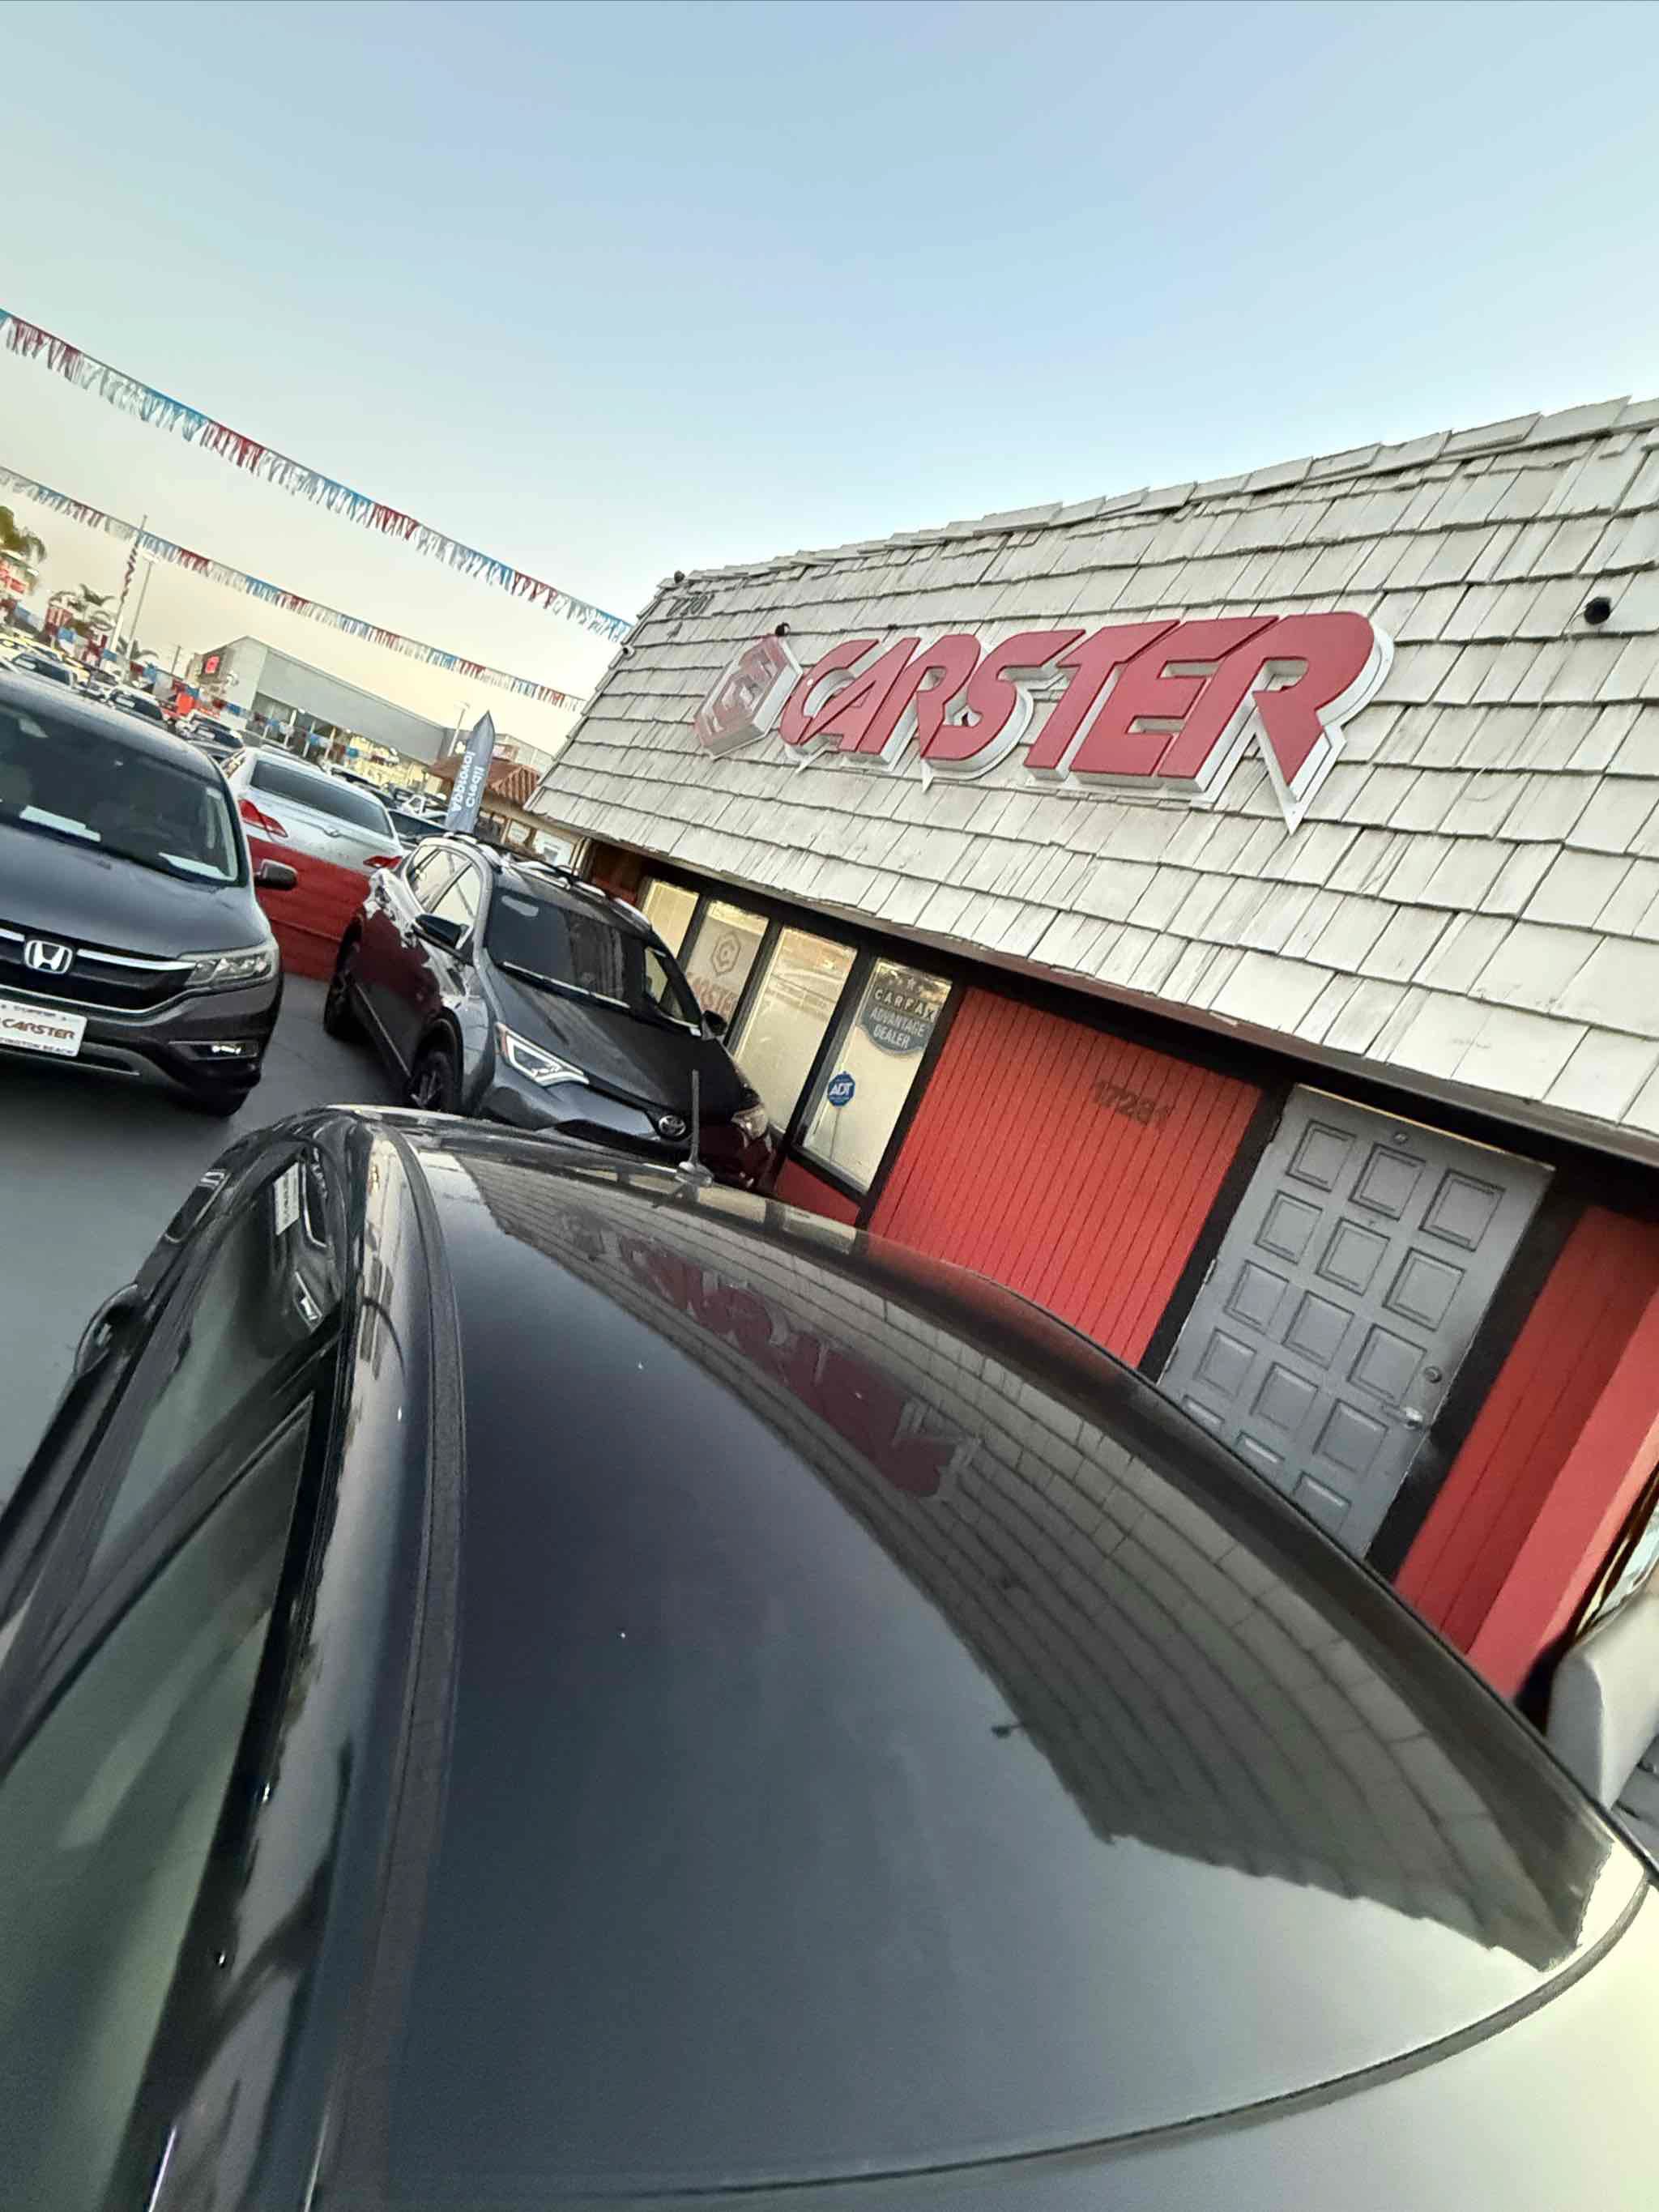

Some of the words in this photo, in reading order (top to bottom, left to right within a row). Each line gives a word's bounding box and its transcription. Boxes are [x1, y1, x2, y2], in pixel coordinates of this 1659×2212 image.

[779, 611, 1389, 825] CARSTER
[874, 989, 938, 1023] CARFAX
[2, 1018, 75, 1039] CARSTER
[870, 1007, 925, 1038] ADVANTAGE
[873, 1023, 911, 1050] DEALER
[830, 1082, 853, 1095] ADT
